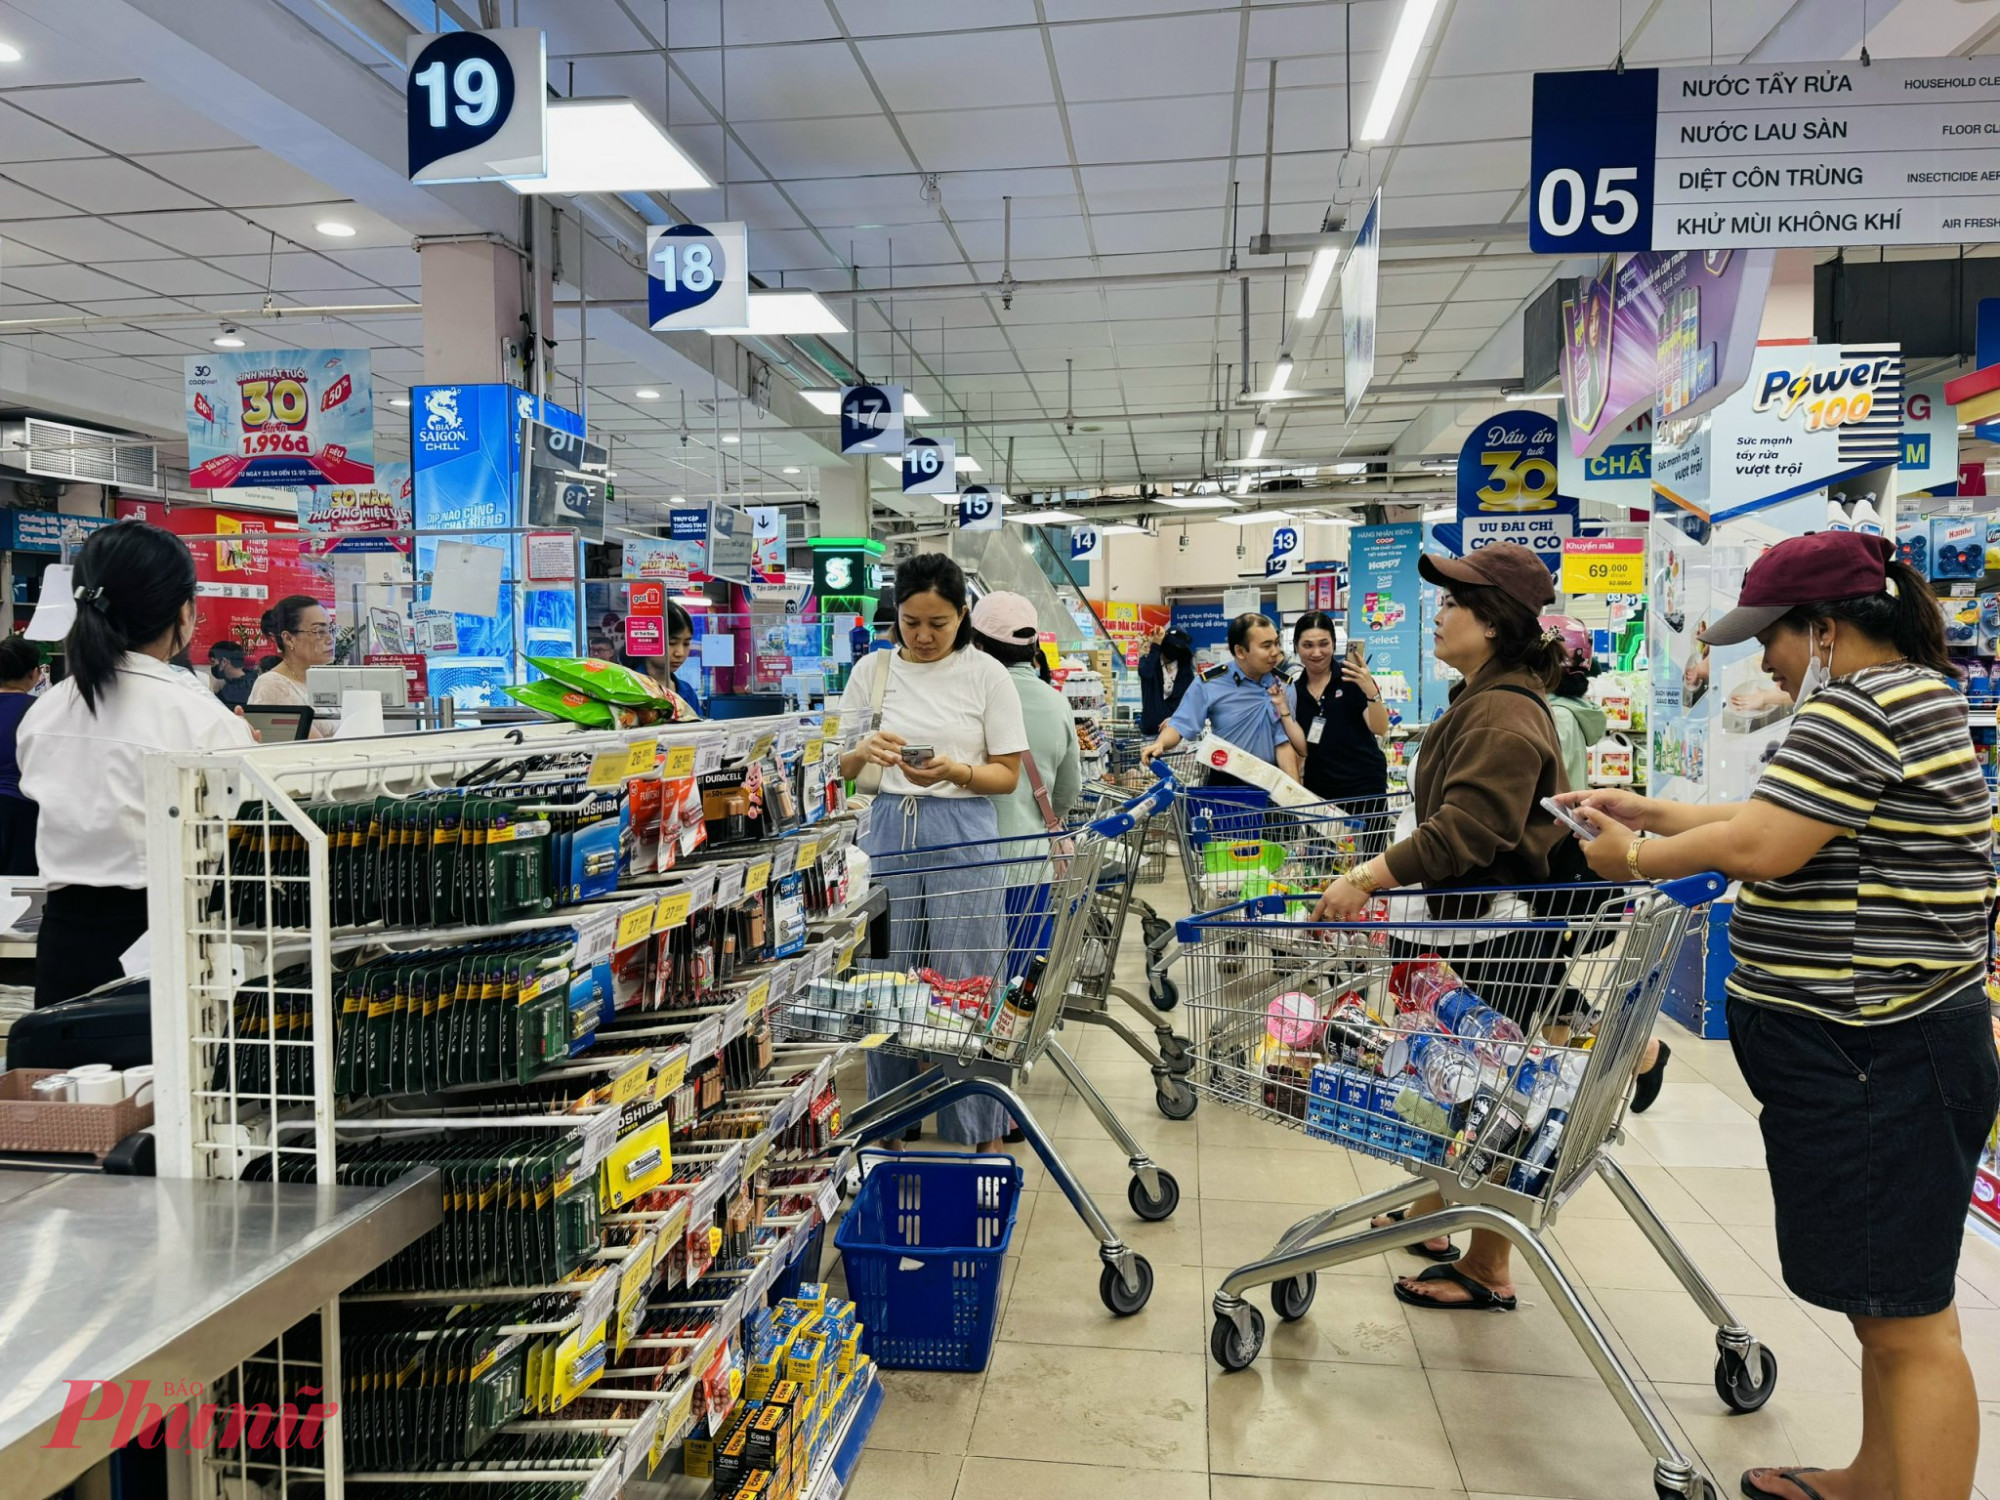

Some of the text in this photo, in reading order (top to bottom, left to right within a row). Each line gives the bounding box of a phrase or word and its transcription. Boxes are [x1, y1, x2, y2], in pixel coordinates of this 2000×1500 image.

[416, 57, 498, 128] 19
[1682, 69, 1853, 98] NƯỚC TẨY RỬA
[1904, 77, 1976, 90] HOUSEHOLD
[1680, 119, 1848, 144] NƯỚC LAU SÀN
[1942, 123, 1981, 136] FLOOR
[1679, 164, 1863, 191] DIỆT CÔN TRÙNG
[1907, 169, 1977, 183] INSECTICIDE
[1538, 167, 1639, 236] 05
[1677, 208, 1902, 236] KHỬ MÙI KHÔNG KHÍ
[1942, 217, 2000, 230] AIR FRESH
[654, 244, 715, 293] 18
[1761, 360, 1890, 408] Power
[241, 379, 307, 426] 30
[1808, 393, 1873, 430] 100
[844, 398, 884, 431] 17
[243, 434, 309, 455] 1.996đ
[1485, 426, 1556, 447] Dấu ấn
[1736, 436, 1793, 447] Sức mạnh
[425, 443, 460, 451] CHILL
[1758, 450, 1779, 460] rửa
[905, 448, 939, 475] 16
[1590, 444, 1651, 477] CHẤ
[1736, 462, 1803, 478] vượt trội
[1476, 451, 1558, 505] 30
[330, 489, 392, 508] 30 NĂM
[962, 494, 989, 516] 15
[1072, 533, 1093, 549] 14
[1274, 533, 1295, 550] 13
[1533, 532, 1562, 550] CÓ
[1566, 541, 1598, 551] Khuyến
[1267, 558, 1284, 571] 12
[1368, 558, 1401, 571] Happy
[786, 603, 797, 614] 33
[1369, 635, 1399, 645] Select
[705, 772, 742, 784] DURACELL
[578, 799, 619, 815] TOSHIBA
[618, 1102, 663, 1129] OSHIBA
